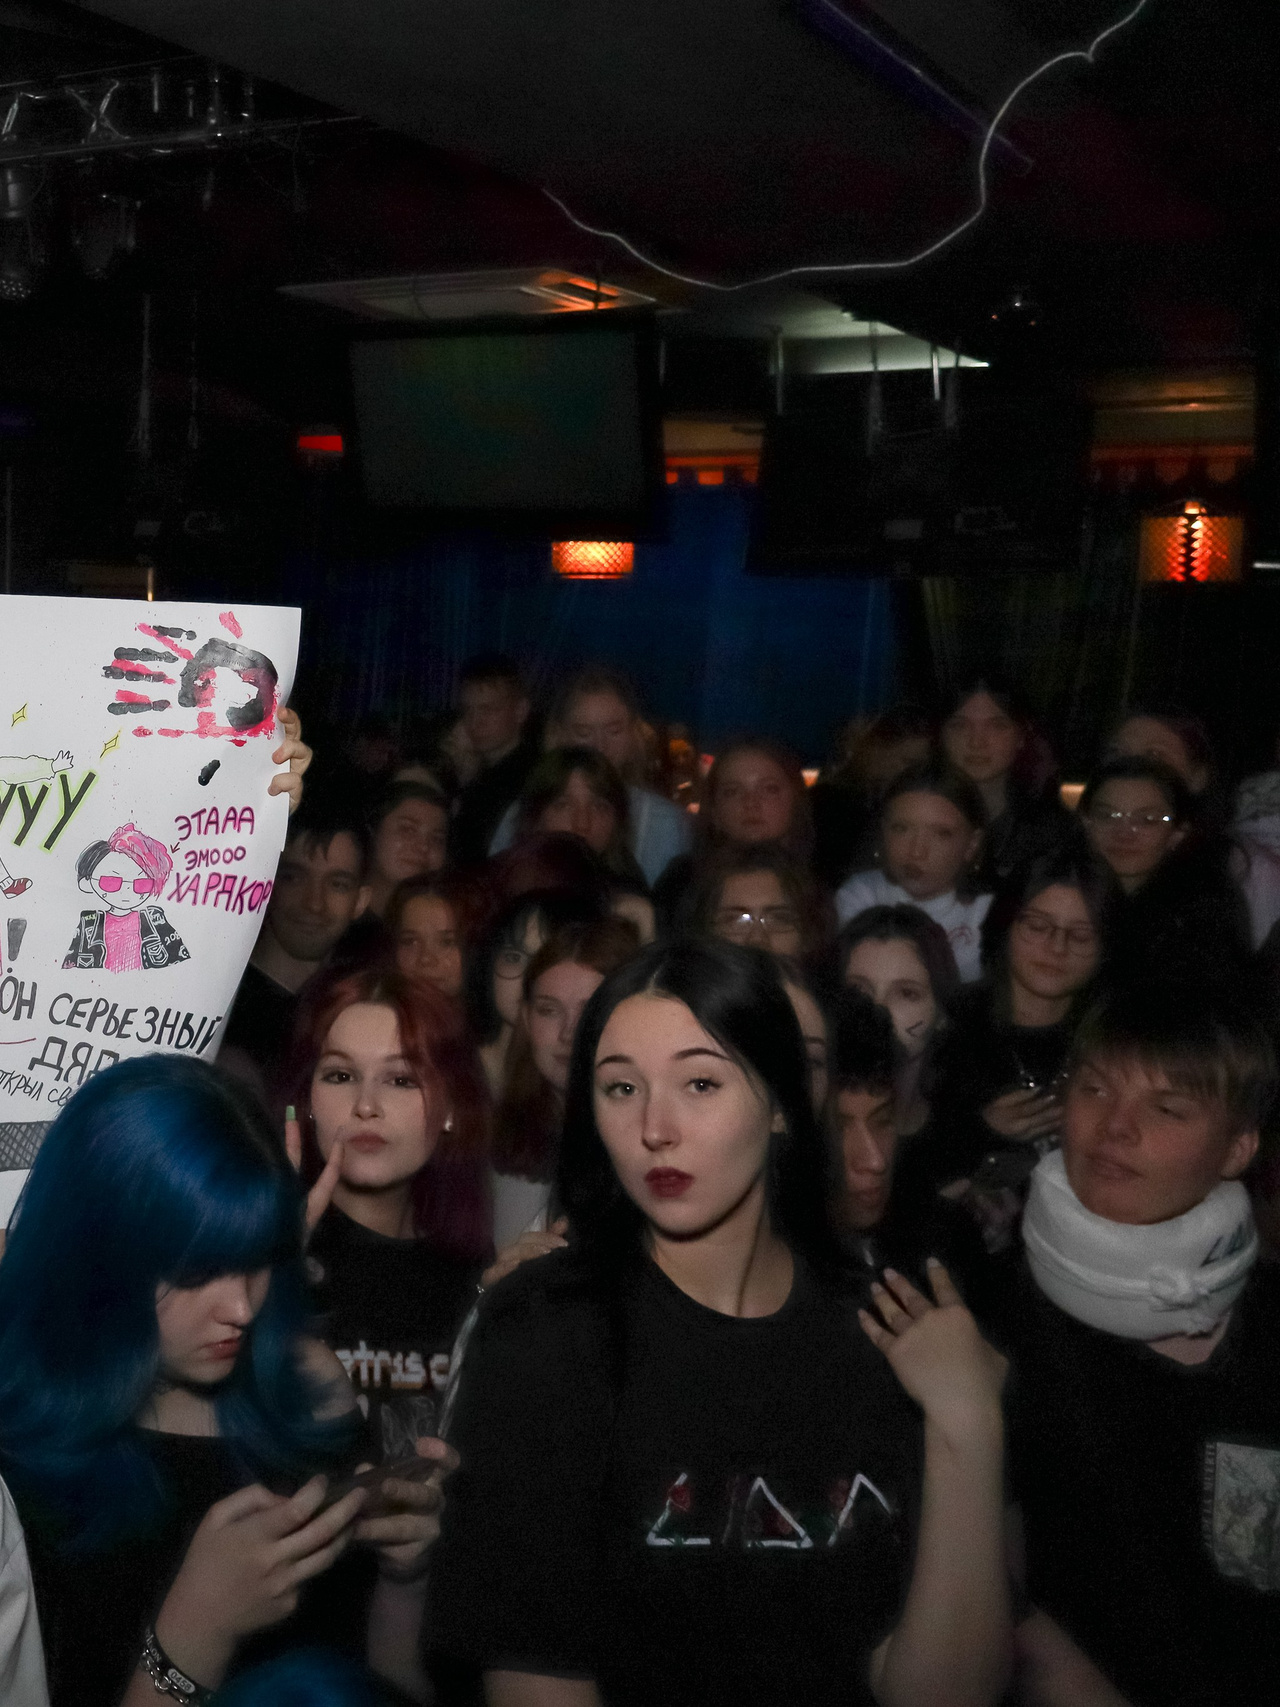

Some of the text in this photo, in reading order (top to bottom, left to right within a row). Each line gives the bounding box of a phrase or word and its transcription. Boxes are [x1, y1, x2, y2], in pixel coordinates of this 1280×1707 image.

[174, 806, 255, 841] ЭТААА
[184, 846, 246, 871] ЭМООО
[167, 872, 273, 915] ХАРДКОР
